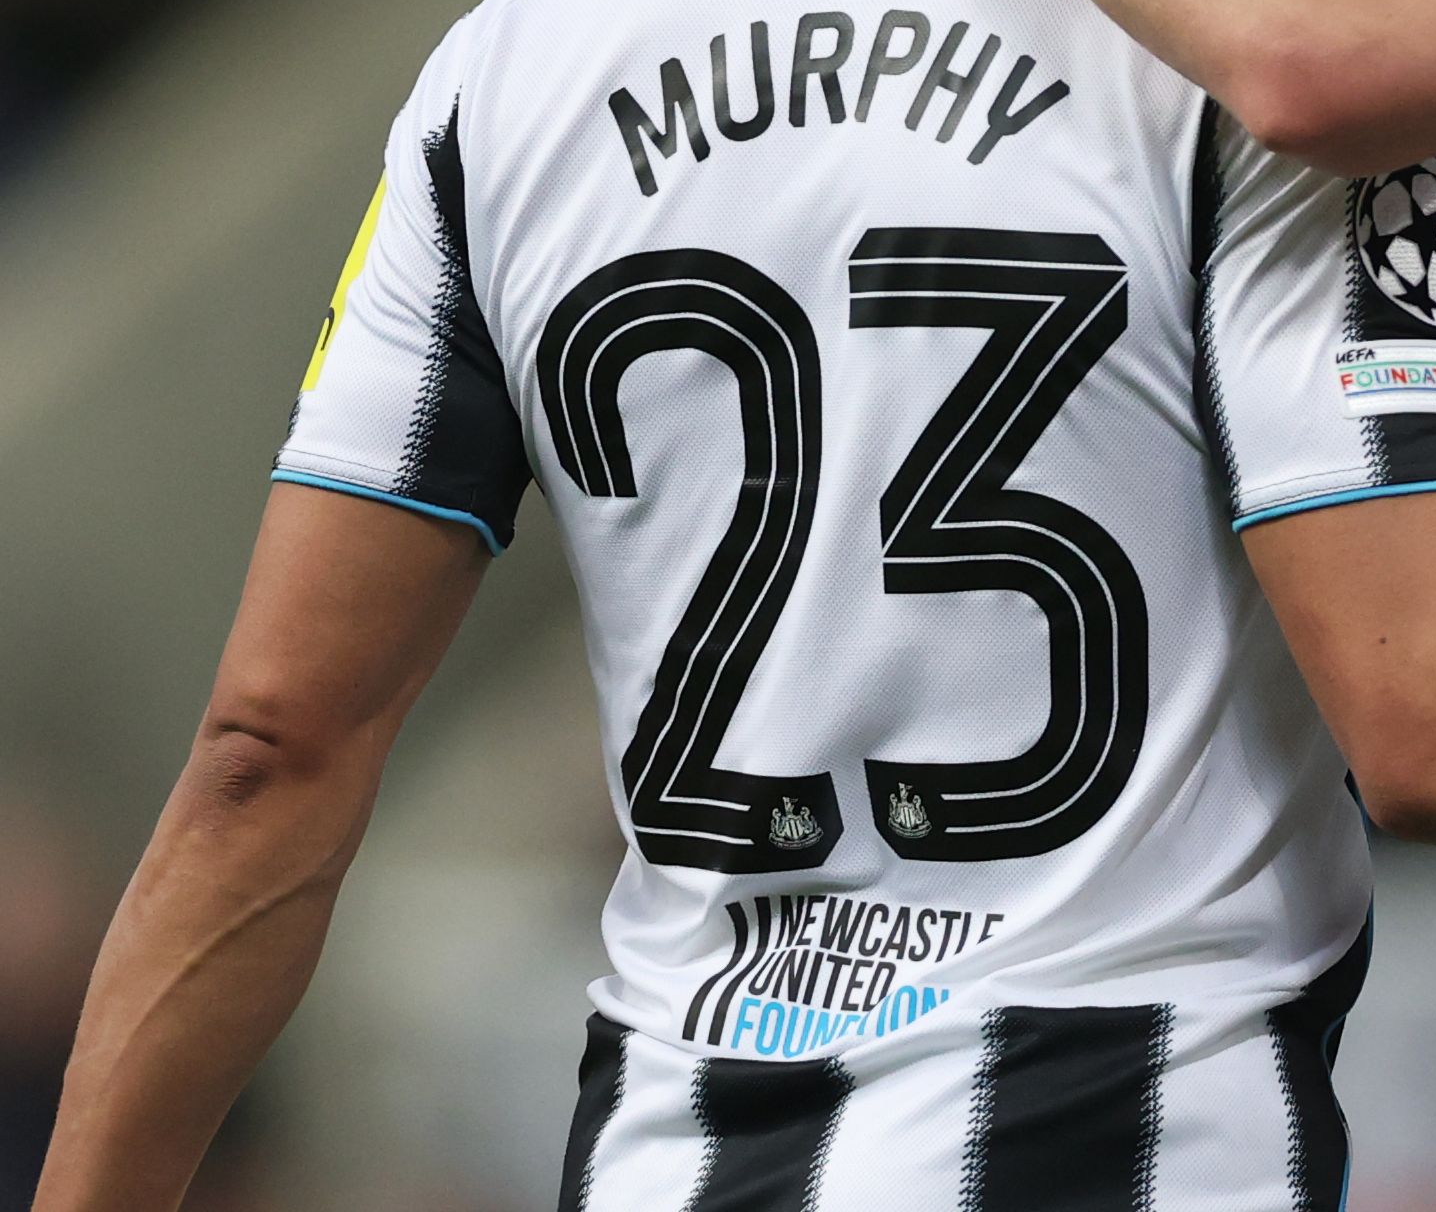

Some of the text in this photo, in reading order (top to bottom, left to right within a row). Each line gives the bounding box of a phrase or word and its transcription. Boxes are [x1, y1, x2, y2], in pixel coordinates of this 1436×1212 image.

[608, 10, 1071, 197] MURPHY
[1336, 348, 1376, 364] UEFA
[532, 227, 1149, 876] 23
[748, 949, 897, 1012] UNITED
